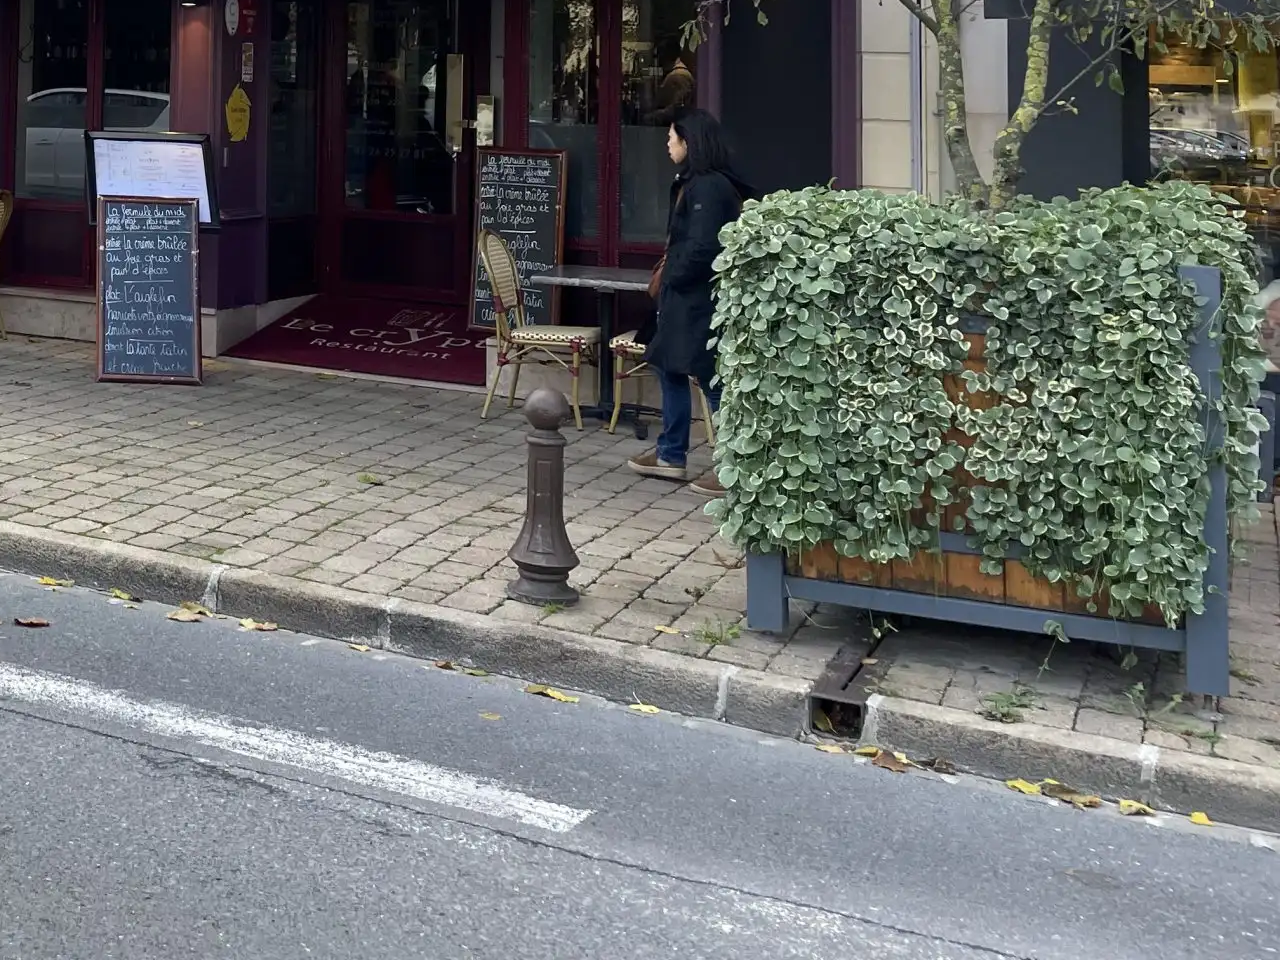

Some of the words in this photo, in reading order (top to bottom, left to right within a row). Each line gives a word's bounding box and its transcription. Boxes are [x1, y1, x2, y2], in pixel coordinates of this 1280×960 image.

[121, 204, 152, 219] formule
[158, 235, 187, 250] brûlée
[280, 318, 334, 332] Le
[309, 337, 452, 361] Restaurant
